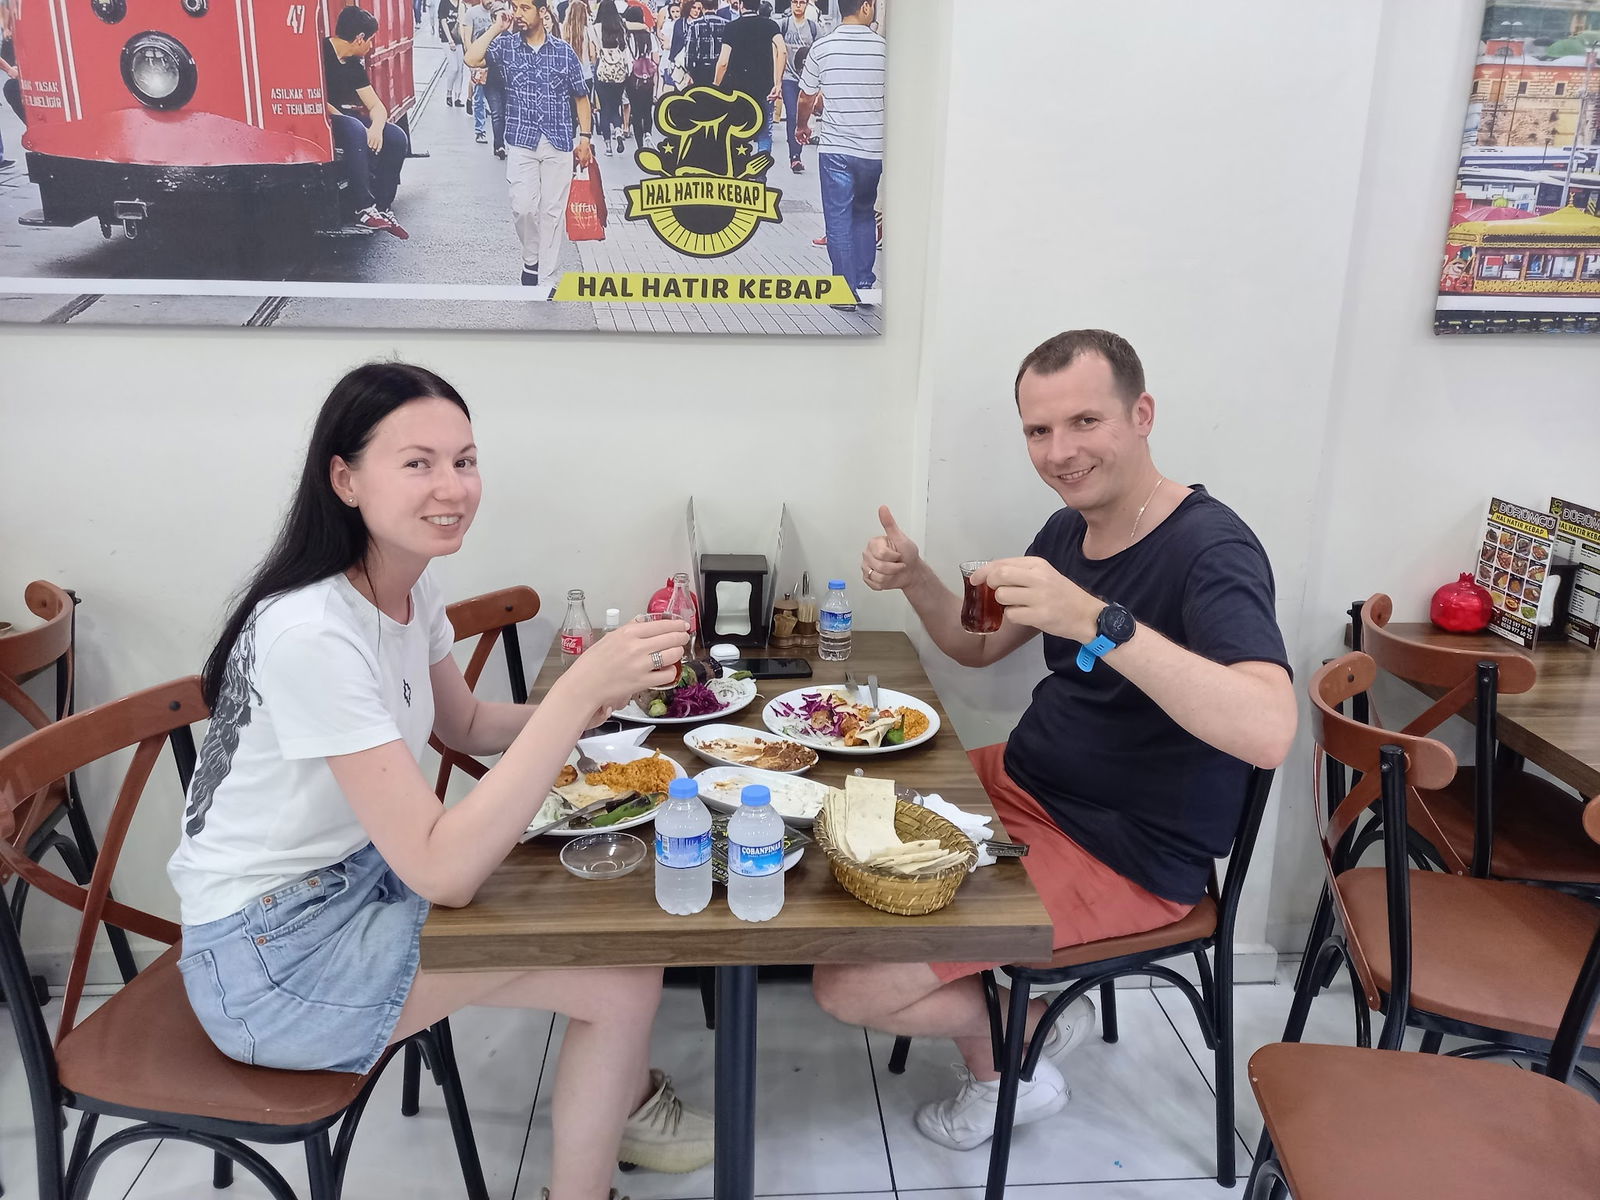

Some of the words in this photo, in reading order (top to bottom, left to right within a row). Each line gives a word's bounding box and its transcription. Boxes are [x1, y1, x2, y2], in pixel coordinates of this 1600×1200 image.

[646, 183, 671, 206] HAL
[675, 181, 714, 202] HATIR
[718, 182, 760, 206] KEBAP
[578, 276, 633, 298] HAL
[642, 277, 729, 299] HATIR
[739, 278, 832, 300] KEBAP
